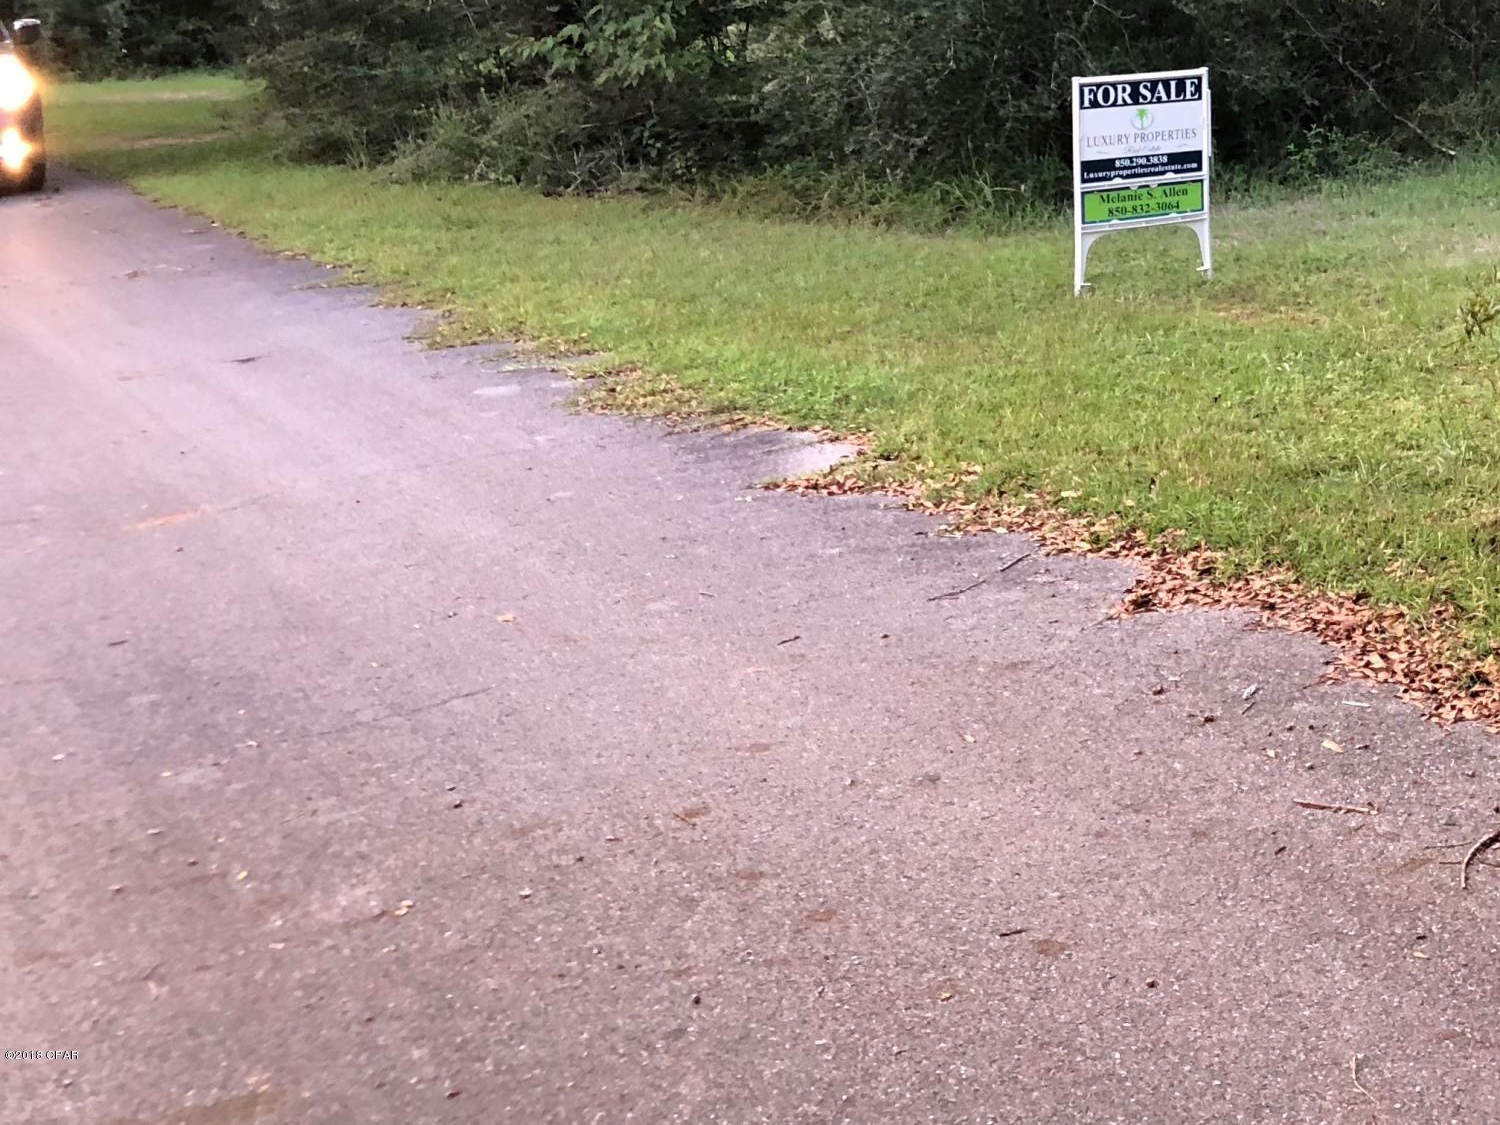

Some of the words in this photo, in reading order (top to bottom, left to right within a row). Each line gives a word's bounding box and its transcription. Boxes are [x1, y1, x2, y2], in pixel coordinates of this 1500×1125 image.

[1082, 83, 1133, 108] FOR
[1139, 78, 1199, 103] SALE
[1087, 134, 1130, 148] LUXURY
[1134, 128, 1197, 144] PROPERTIES
[1115, 155, 1168, 168] 850.290.3838
[1099, 189, 1143, 205] Melanie
[1146, 190, 1157, 200] S.
[1160, 187, 1188, 199] Allen
[1107, 200, 1180, 218] 850-832-3064
